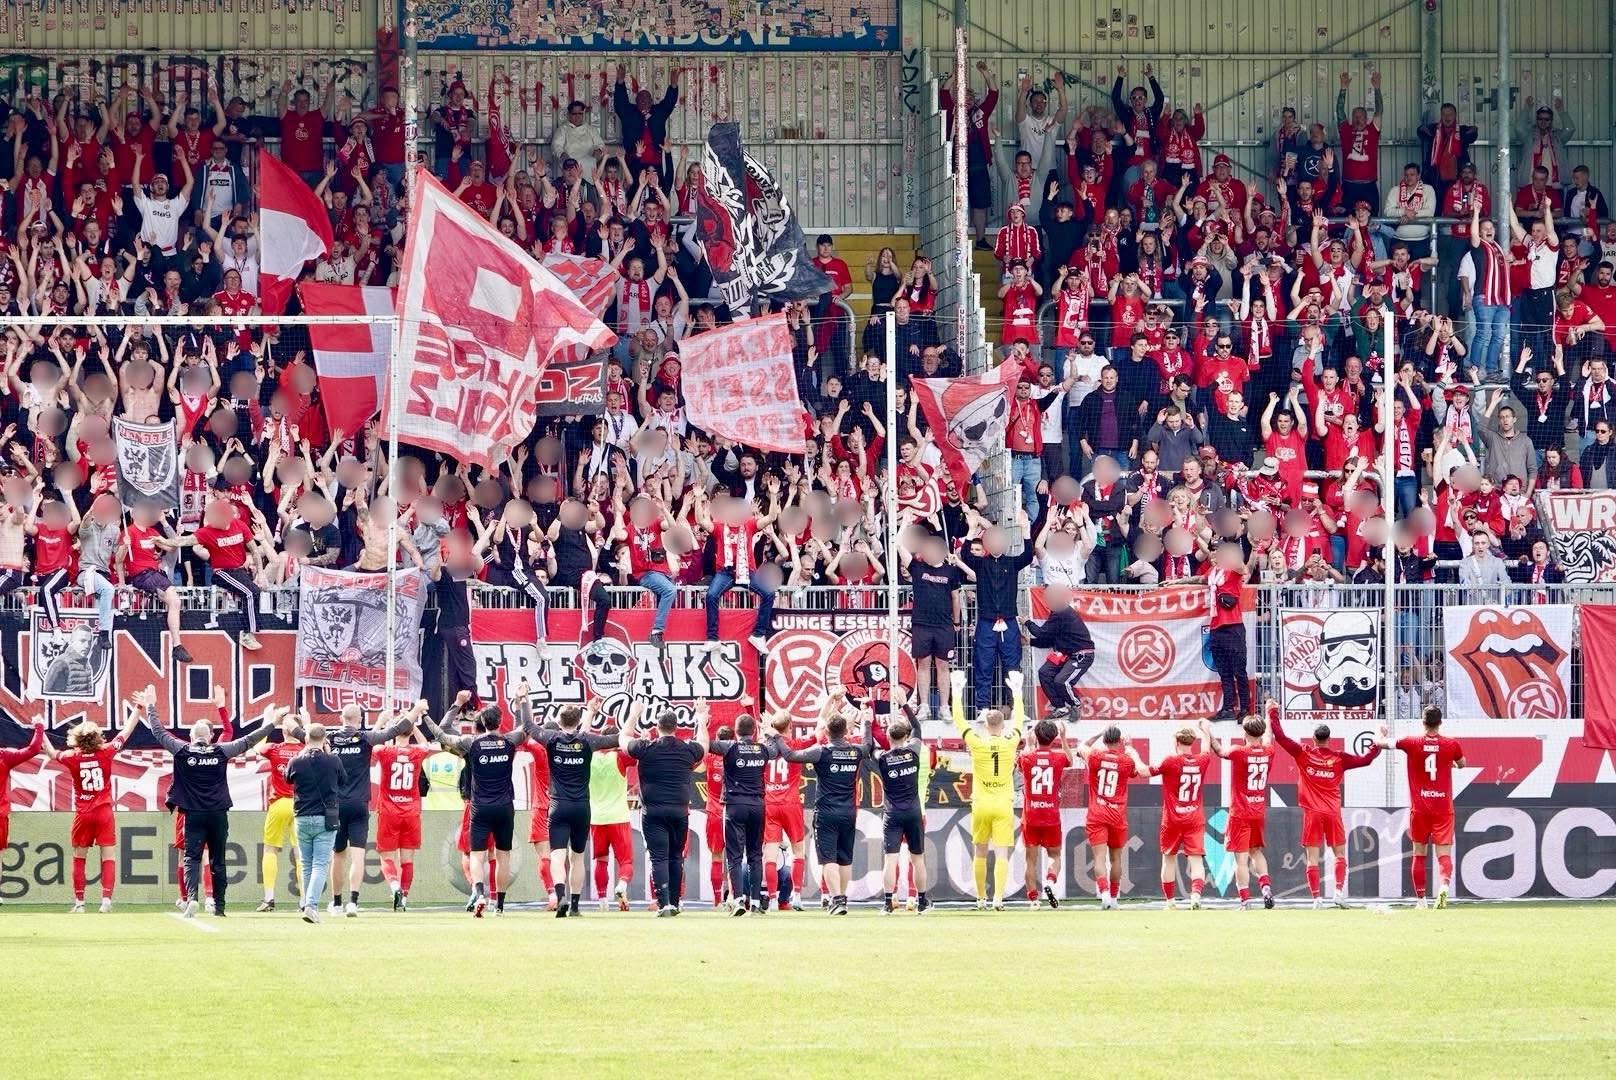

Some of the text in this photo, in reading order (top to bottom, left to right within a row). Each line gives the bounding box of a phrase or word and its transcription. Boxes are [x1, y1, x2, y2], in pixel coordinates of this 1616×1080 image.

[1072, 589, 1212, 616] FANCLU
[772, 616, 832, 630] JUNGE
[1284, 635, 1320, 669] BANDA
[1343, 711, 1374, 720] ESSEN
[198, 758, 219, 766] JAKO
[490, 755, 509, 763] JAKO
[768, 757, 789, 784] 14
[840, 764, 857, 772] JAKO
[991, 752, 999, 777] 1
[1424, 753, 1438, 781] 4
[80, 768, 105, 792] 28
[390, 763, 414, 790] 26
[1031, 766, 1054, 795] 24
[1097, 768, 1119, 798] 19
[1178, 774, 1200, 802] 27
[1247, 763, 1269, 791] 23
